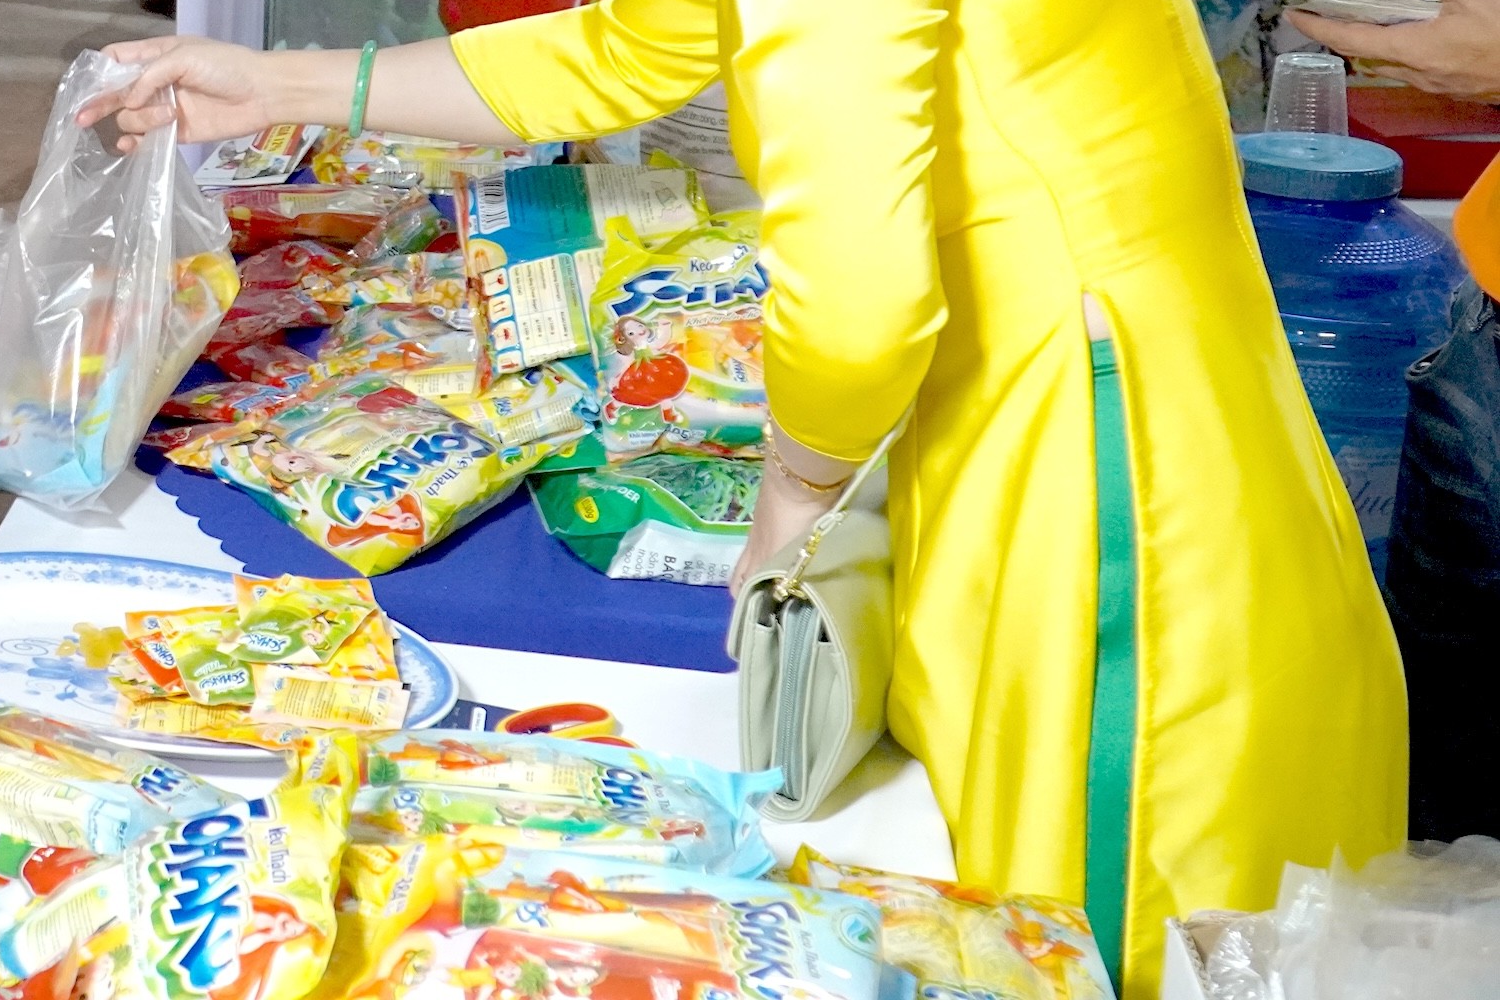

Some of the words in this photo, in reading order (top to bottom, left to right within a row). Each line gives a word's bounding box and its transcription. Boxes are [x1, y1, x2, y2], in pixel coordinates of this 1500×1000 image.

[336, 421, 498, 524] SOHAKU
[425, 468, 461, 497] Thạch
[729, 900, 802, 1000] SOHAK
